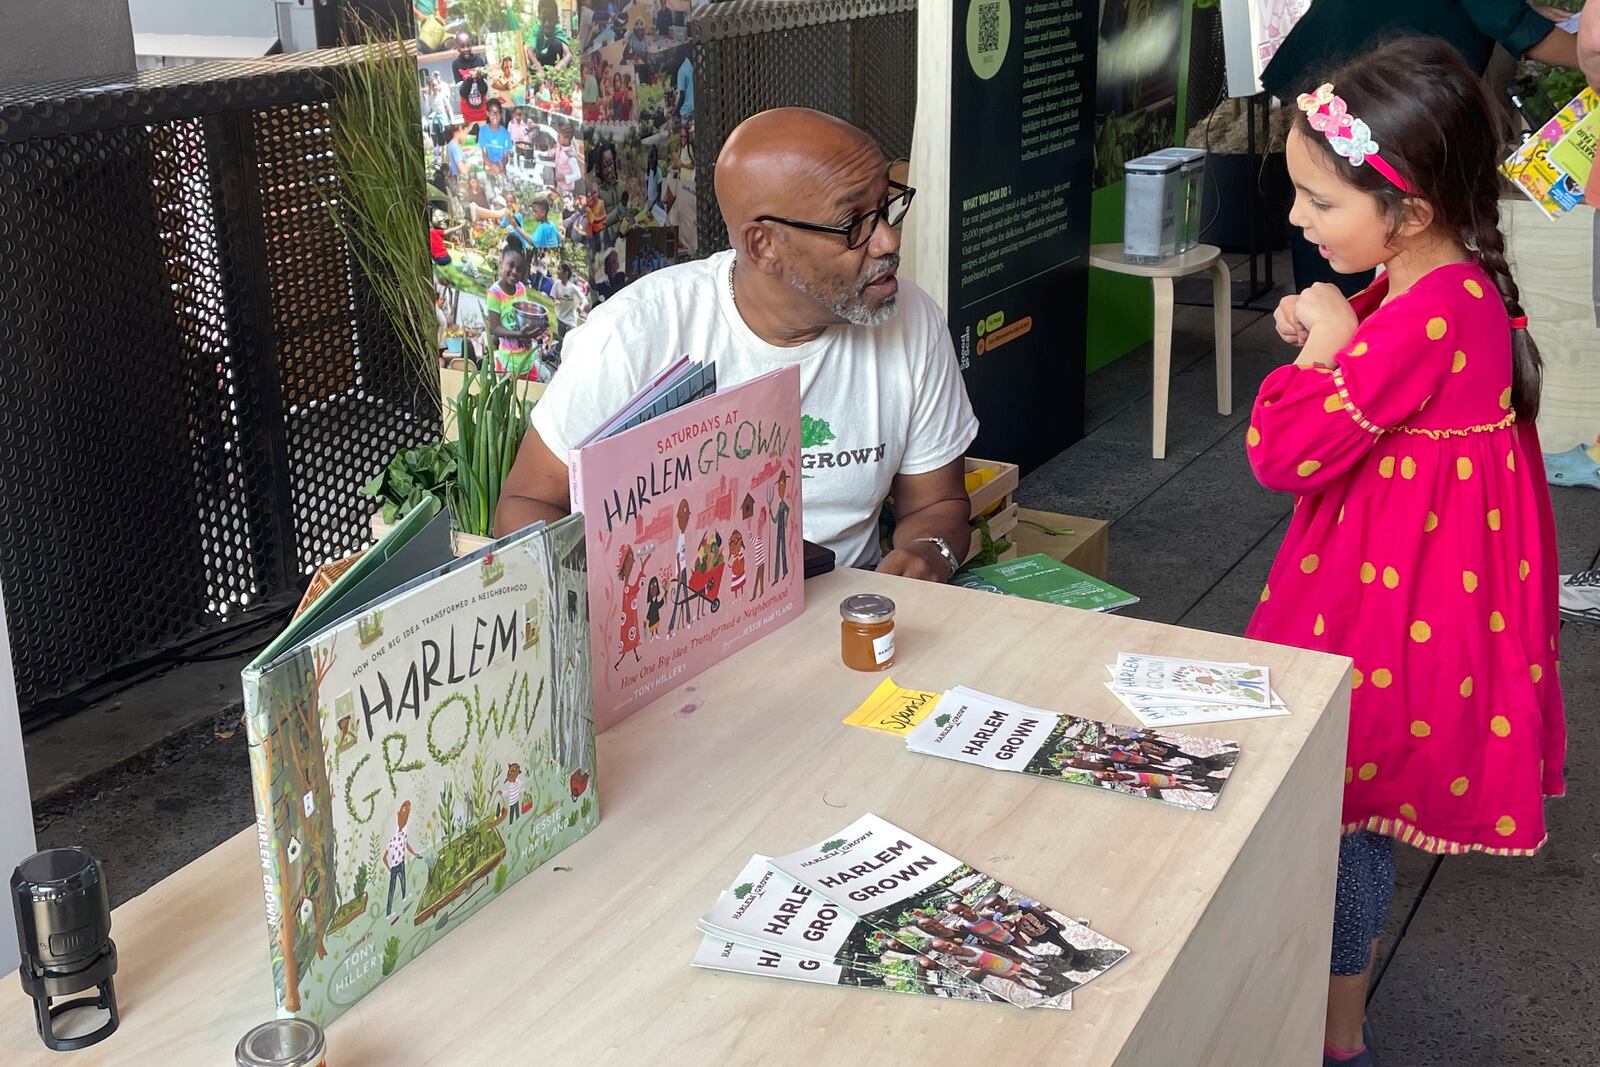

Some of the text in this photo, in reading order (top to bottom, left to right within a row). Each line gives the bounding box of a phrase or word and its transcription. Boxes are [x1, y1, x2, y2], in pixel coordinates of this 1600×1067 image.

[1576, 128, 1592, 144] FAIR
[1576, 140, 1596, 159] MATE
[962, 186, 1008, 212] WHAT YOU CAN DO
[657, 410, 738, 454] SATURDAYS AT
[604, 420, 790, 533] HARLEM GROWN
[801, 443, 886, 469] GROWN
[352, 660, 370, 678] HOW
[372, 647, 386, 662] ONE
[388, 637, 401, 650] BIG
[403, 624, 420, 639] IDEA
[422, 599, 469, 627] TRANSFORMED
[478, 583, 528, 601] NEIGHBORHOOD
[620, 674, 638, 690] How
[640, 664, 656, 680] One
[658, 654, 670, 670] Big
[672, 646, 688, 660] Idea
[690, 620, 735, 649] Transformed
[743, 589, 788, 622] Neighborhood
[742, 602, 794, 638] JESSIE HARTLAND
[359, 610, 518, 742] HARLEM
[633, 663, 687, 698] TONY HILLERY
[1120, 656, 1142, 688] HARLEM
[880, 693, 934, 730] Spanish
[934, 704, 968, 744] HARLEM GROWN
[345, 670, 545, 825] GROWN
[962, 710, 1009, 756] HARLEM
[994, 718, 1040, 760] GROWN
[521, 818, 569, 858] HARTLAND
[532, 808, 561, 838] JESSIE
[800, 830, 874, 868] HARLEM GROWN
[817, 840, 912, 888] HARLEM
[732, 870, 774, 920] HARLEM GROWN
[848, 855, 938, 902] GROWN
[263, 874, 278, 927] GROWN
[763, 882, 813, 936] HARLE
[802, 900, 839, 942] GRO
[343, 942, 376, 970] TONY
[721, 941, 735, 958] HARL
[335, 952, 384, 994] HILLERY
